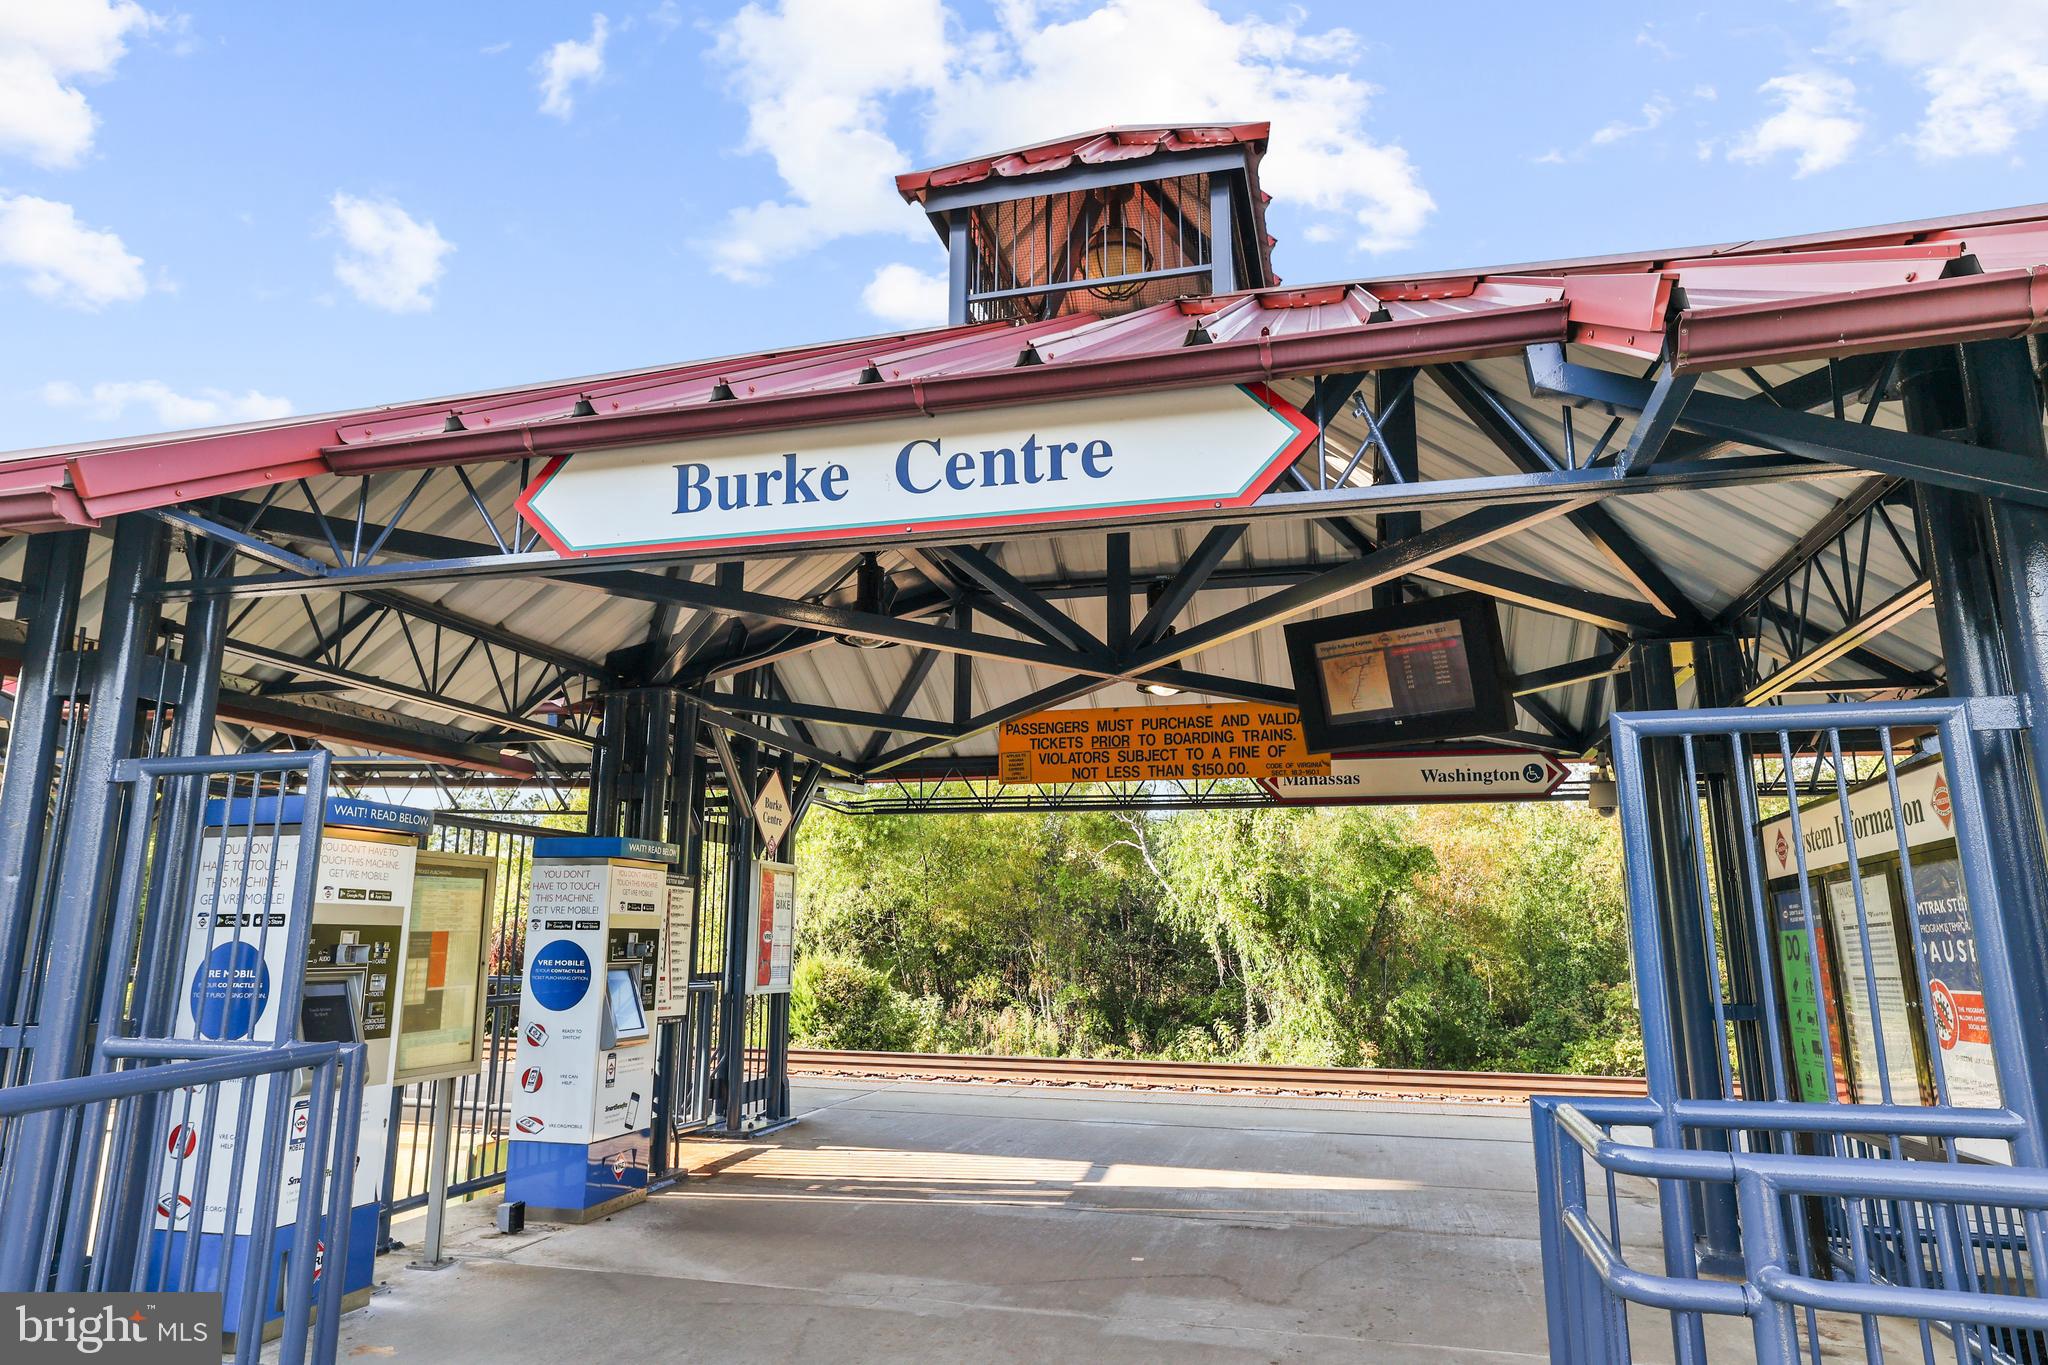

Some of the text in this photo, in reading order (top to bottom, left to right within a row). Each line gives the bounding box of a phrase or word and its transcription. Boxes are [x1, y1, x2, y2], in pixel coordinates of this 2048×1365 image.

[671, 431, 1114, 515] Burke Centre
[1005, 721, 1089, 735] PASSENGERS
[1097, 719, 1134, 732] MUST
[1141, 715, 1213, 731] PURCHASE
[1221, 713, 1250, 727] AND
[1029, 728, 1297, 750] TICKETS PRIOR TO BOARDING TRAINS.
[1039, 744, 1287, 765] VIOLATORS SUBJECT TO A FINE OF
[1072, 762, 1249, 780] NOT LESS THAN $150.00.
[1283, 767, 1520, 786] Manassas Washington
[764, 796, 783, 811] Burke
[334, 804, 429, 827] WAIT! READ BELOW.
[762, 811, 783, 826] Centre
[218, 843, 240, 855] OU
[341, 843, 366, 853] DON'T
[368, 846, 387, 856] HAVE
[388, 848, 399, 858] TO
[628, 843, 647, 852] WAIT!
[648, 845, 661, 856] READ
[202, 861, 230, 872] HAE
[348, 856, 364, 867] THIS
[328, 868, 344, 878] GET
[345, 869, 359, 880] VRE
[543, 870, 591, 879] YOU DON'T
[206, 877, 228, 888] THS
[532, 881, 600, 891] HAVE TO TOUCH
[200, 894, 214, 905] GE
[535, 893, 554, 902] THIS
[532, 905, 599, 915] GET VRE MOBILE!
[775, 899, 791, 911] BIKE
[1916, 899, 1947, 916] MTRAK
[1785, 934, 1800, 961] DO
[554, 959, 585, 967] MOBILE
[208, 969, 256, 978] RE MOBIL
[288, 1143, 305, 1152] MOBIL
